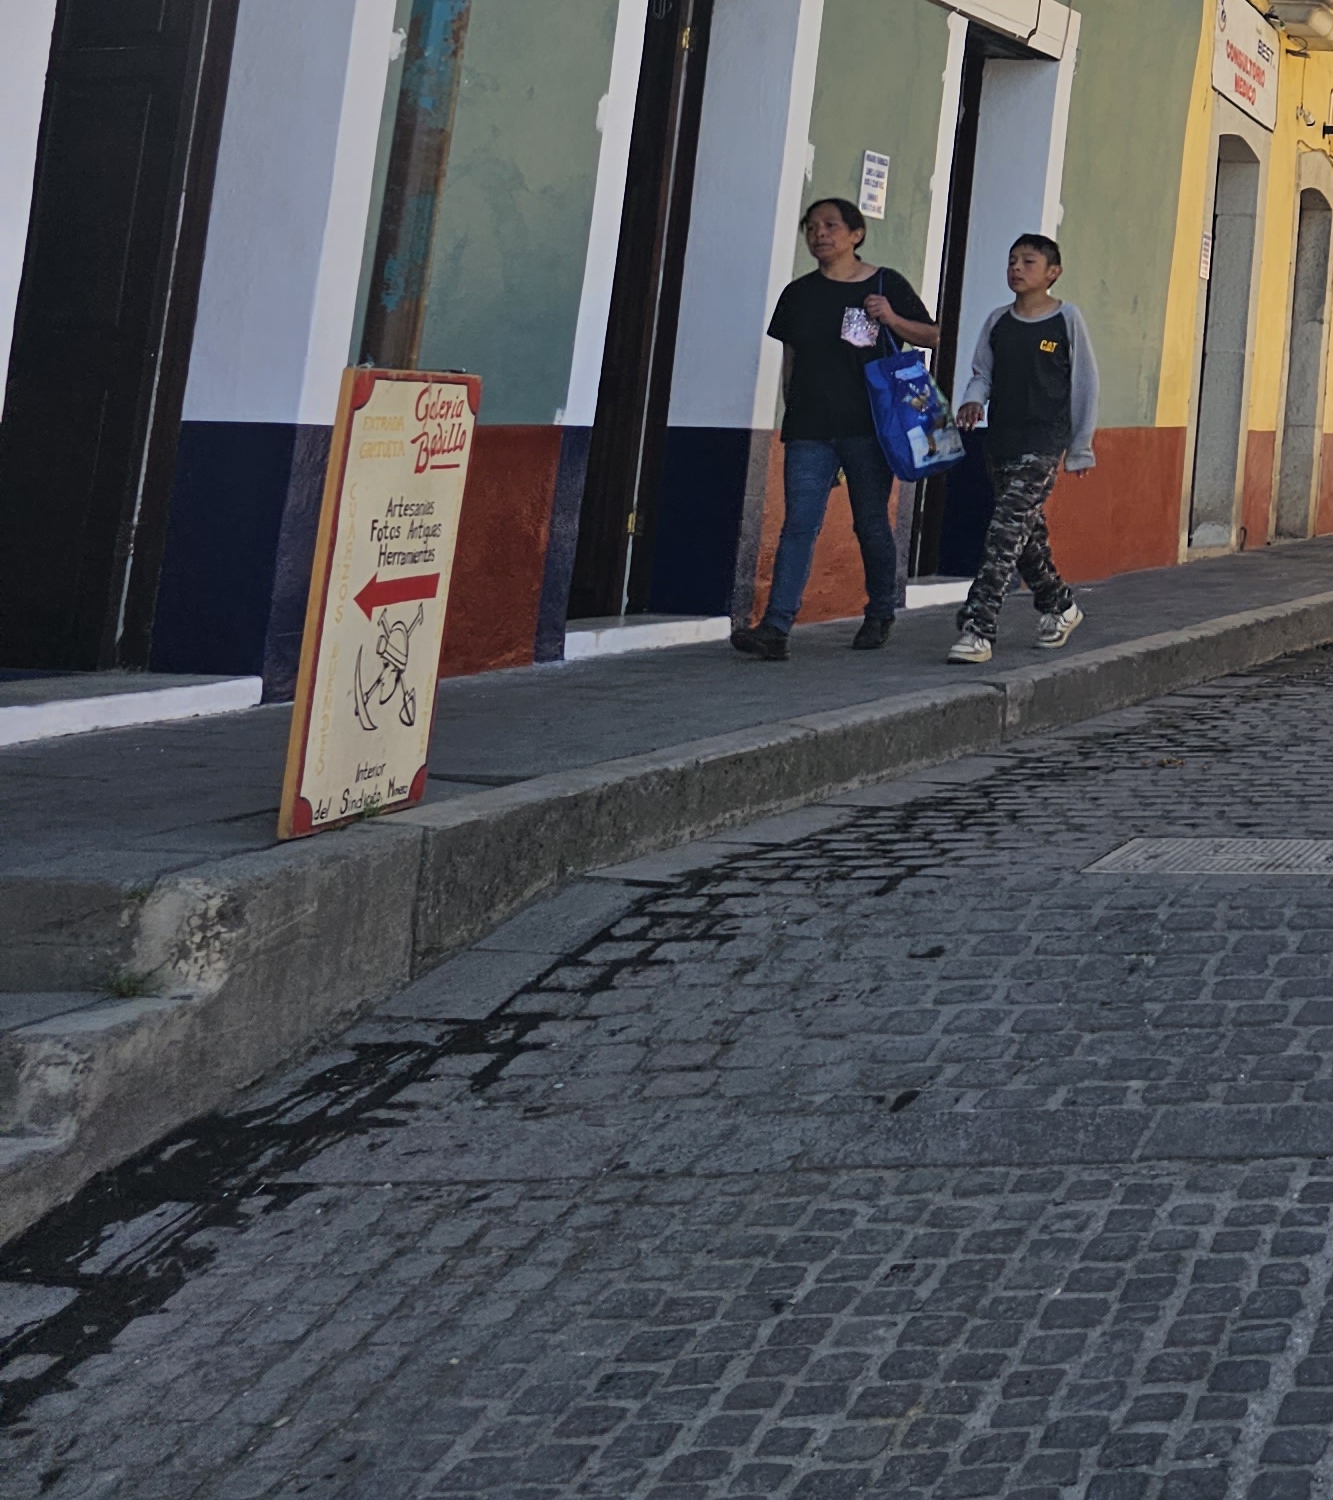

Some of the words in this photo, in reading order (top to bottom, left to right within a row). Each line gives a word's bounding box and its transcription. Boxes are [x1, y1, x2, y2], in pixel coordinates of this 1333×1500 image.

[1226, 39, 1266, 88] CONSULTORIO
[1234, 72, 1257, 106] MEDICO
[1040, 340, 1058, 352] CAT
[415, 386, 464, 430] Galeria
[370, 519, 401, 542] Fotos
[378, 545, 436, 568] Herramientas
[355, 761, 386, 783] Interior
[314, 796, 332, 820] del
